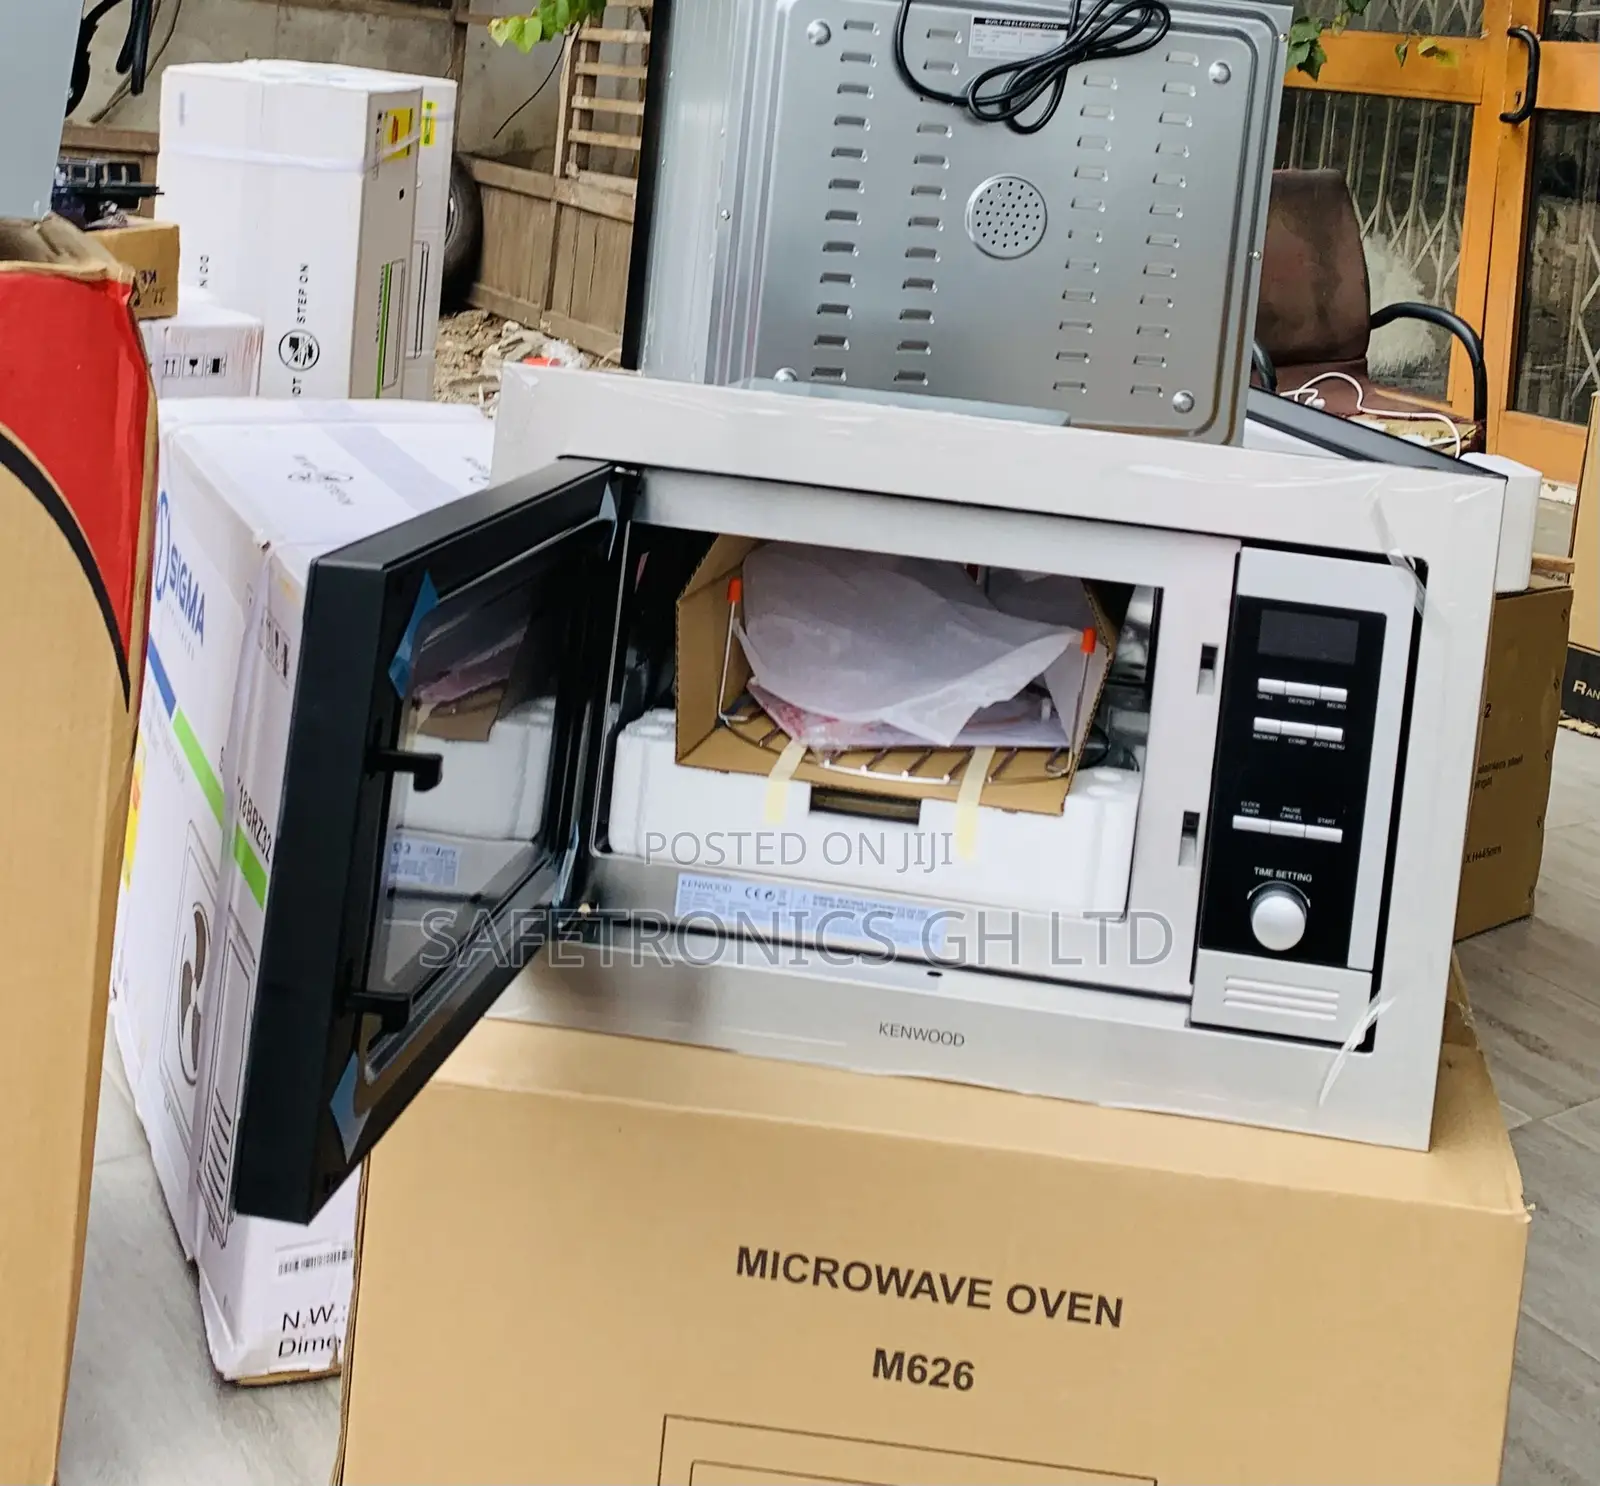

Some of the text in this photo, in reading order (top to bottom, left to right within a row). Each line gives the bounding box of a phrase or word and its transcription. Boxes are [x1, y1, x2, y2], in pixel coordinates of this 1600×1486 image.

[296, 264, 308, 324] STEP ON
[168, 542, 206, 647] SIGMA
[1312, 740, 1346, 751] AUTO MENU
[1316, 817, 1337, 825] START
[681, 879, 732, 893] KENWOOD
[1253, 866, 1314, 883] TIME SETTING
[878, 1021, 965, 1048] KENWOOD
[735, 1245, 1124, 1328] MICROWAVE OVEN
[871, 1347, 976, 1392] M626
